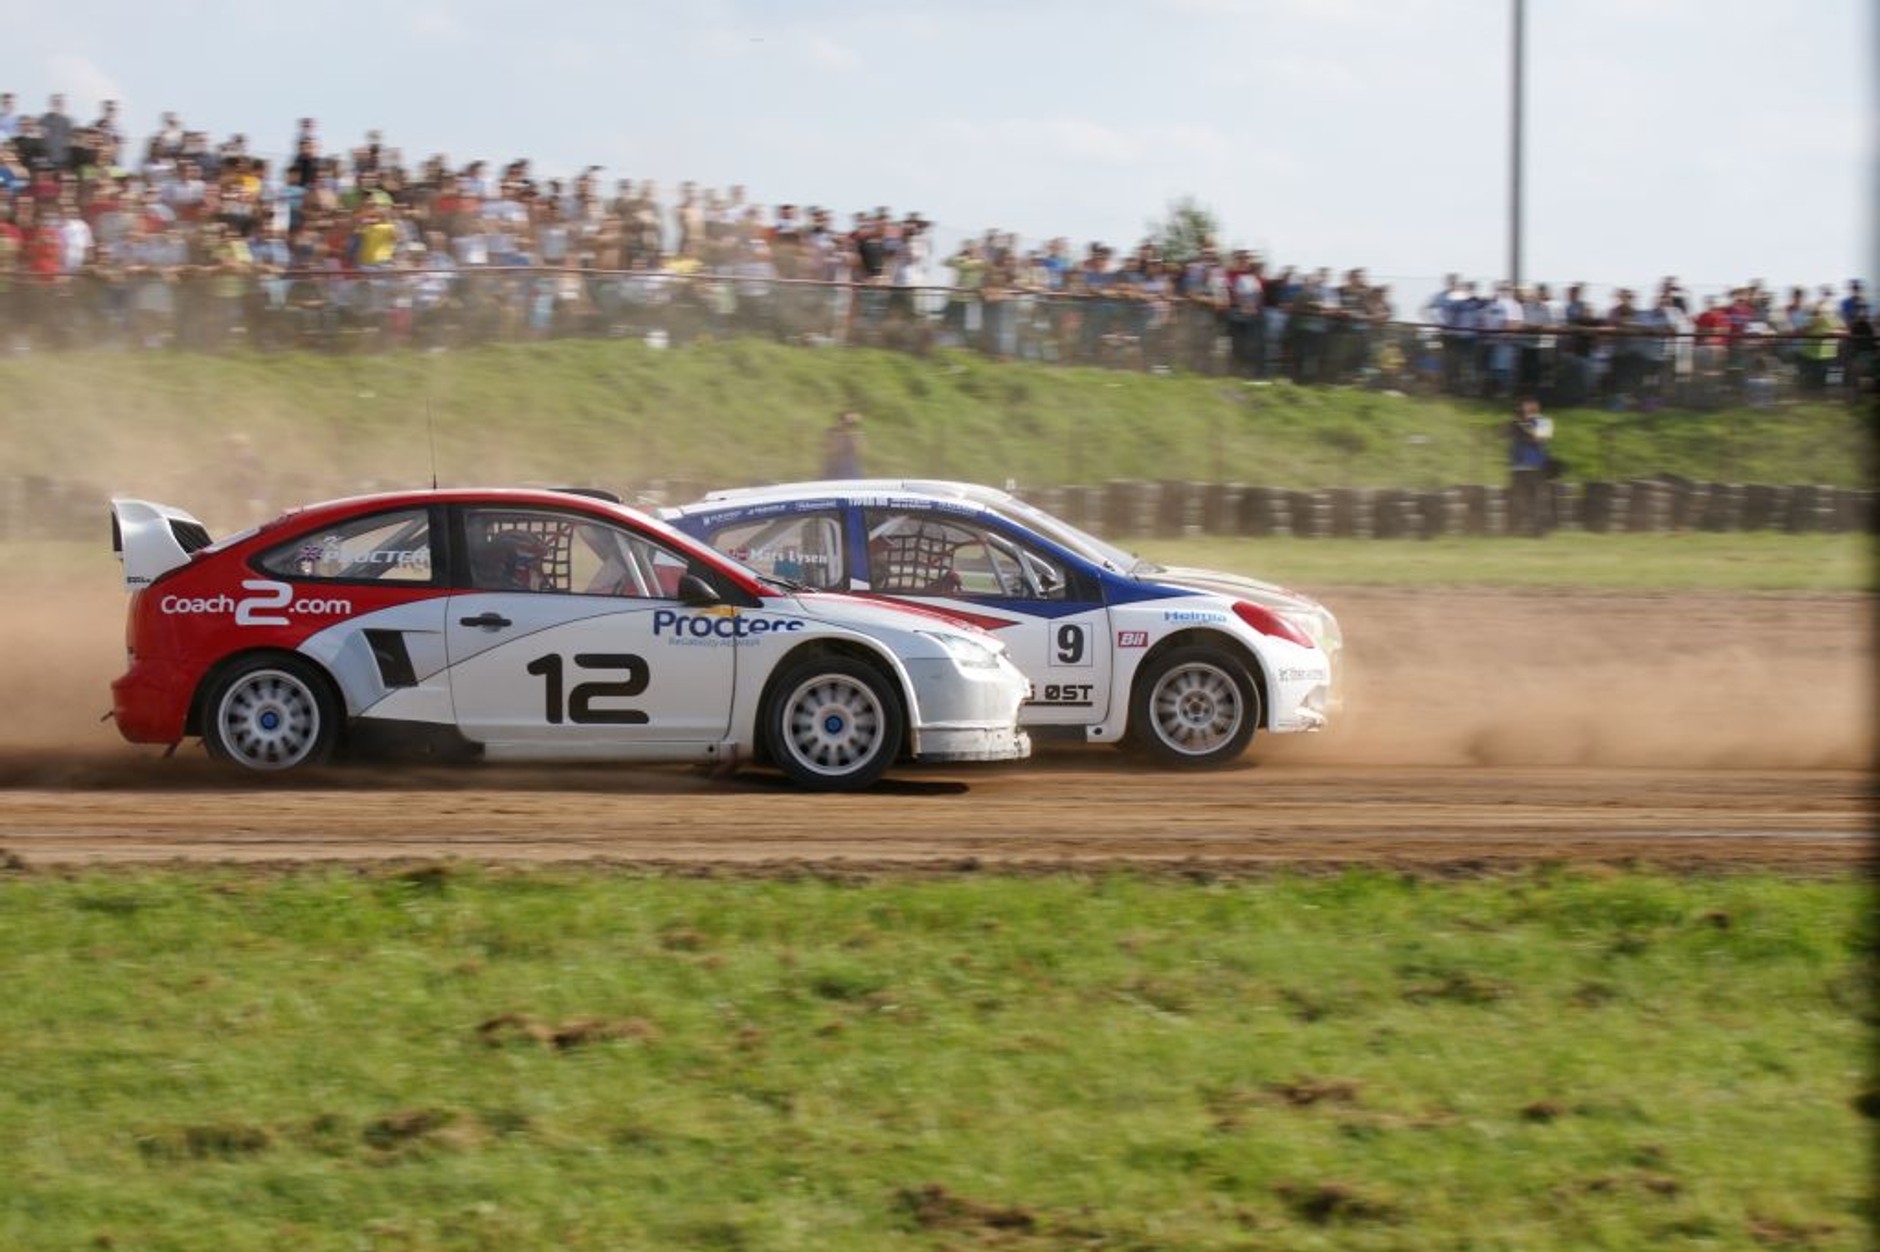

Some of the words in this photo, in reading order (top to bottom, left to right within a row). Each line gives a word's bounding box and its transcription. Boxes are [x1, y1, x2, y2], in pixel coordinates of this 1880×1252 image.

[323, 550, 430, 565] POCTER
[161, 580, 351, 626] Coach2.com
[1057, 624, 1085, 664] 9
[1120, 633, 1146, 646] Bil
[527, 653, 650, 724] 12
[1044, 684, 1094, 701] ØST
